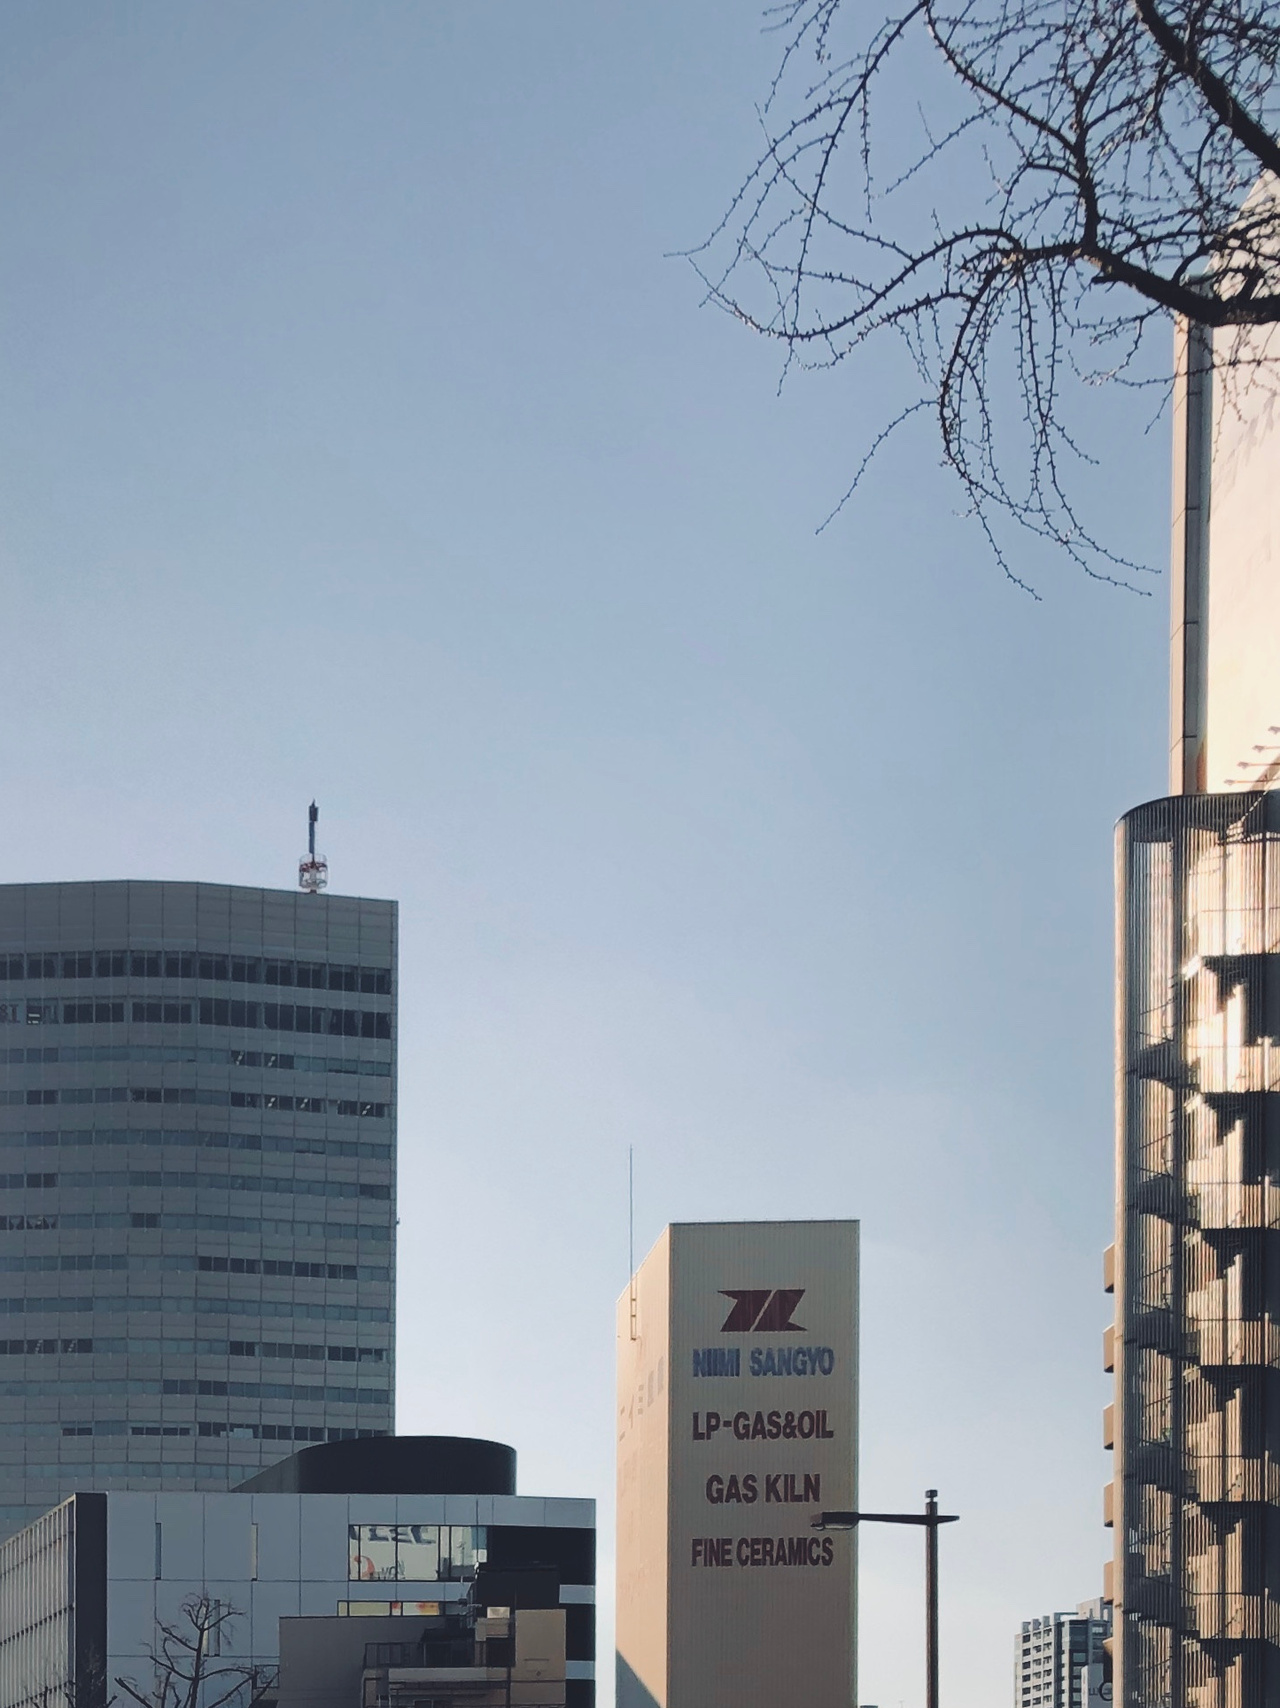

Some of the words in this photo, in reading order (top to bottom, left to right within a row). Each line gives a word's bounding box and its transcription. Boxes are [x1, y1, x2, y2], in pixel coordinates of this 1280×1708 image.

[692, 1347, 740, 1377] NIIMI
[749, 1346, 835, 1377] SANGYO
[692, 1409, 834, 1440] LP-GAS&OIL
[705, 1473, 758, 1504] GAS
[765, 1473, 821, 1503] KILN
[691, 1537, 733, 1567] FINE
[736, 1536, 834, 1567] CERAMICS
